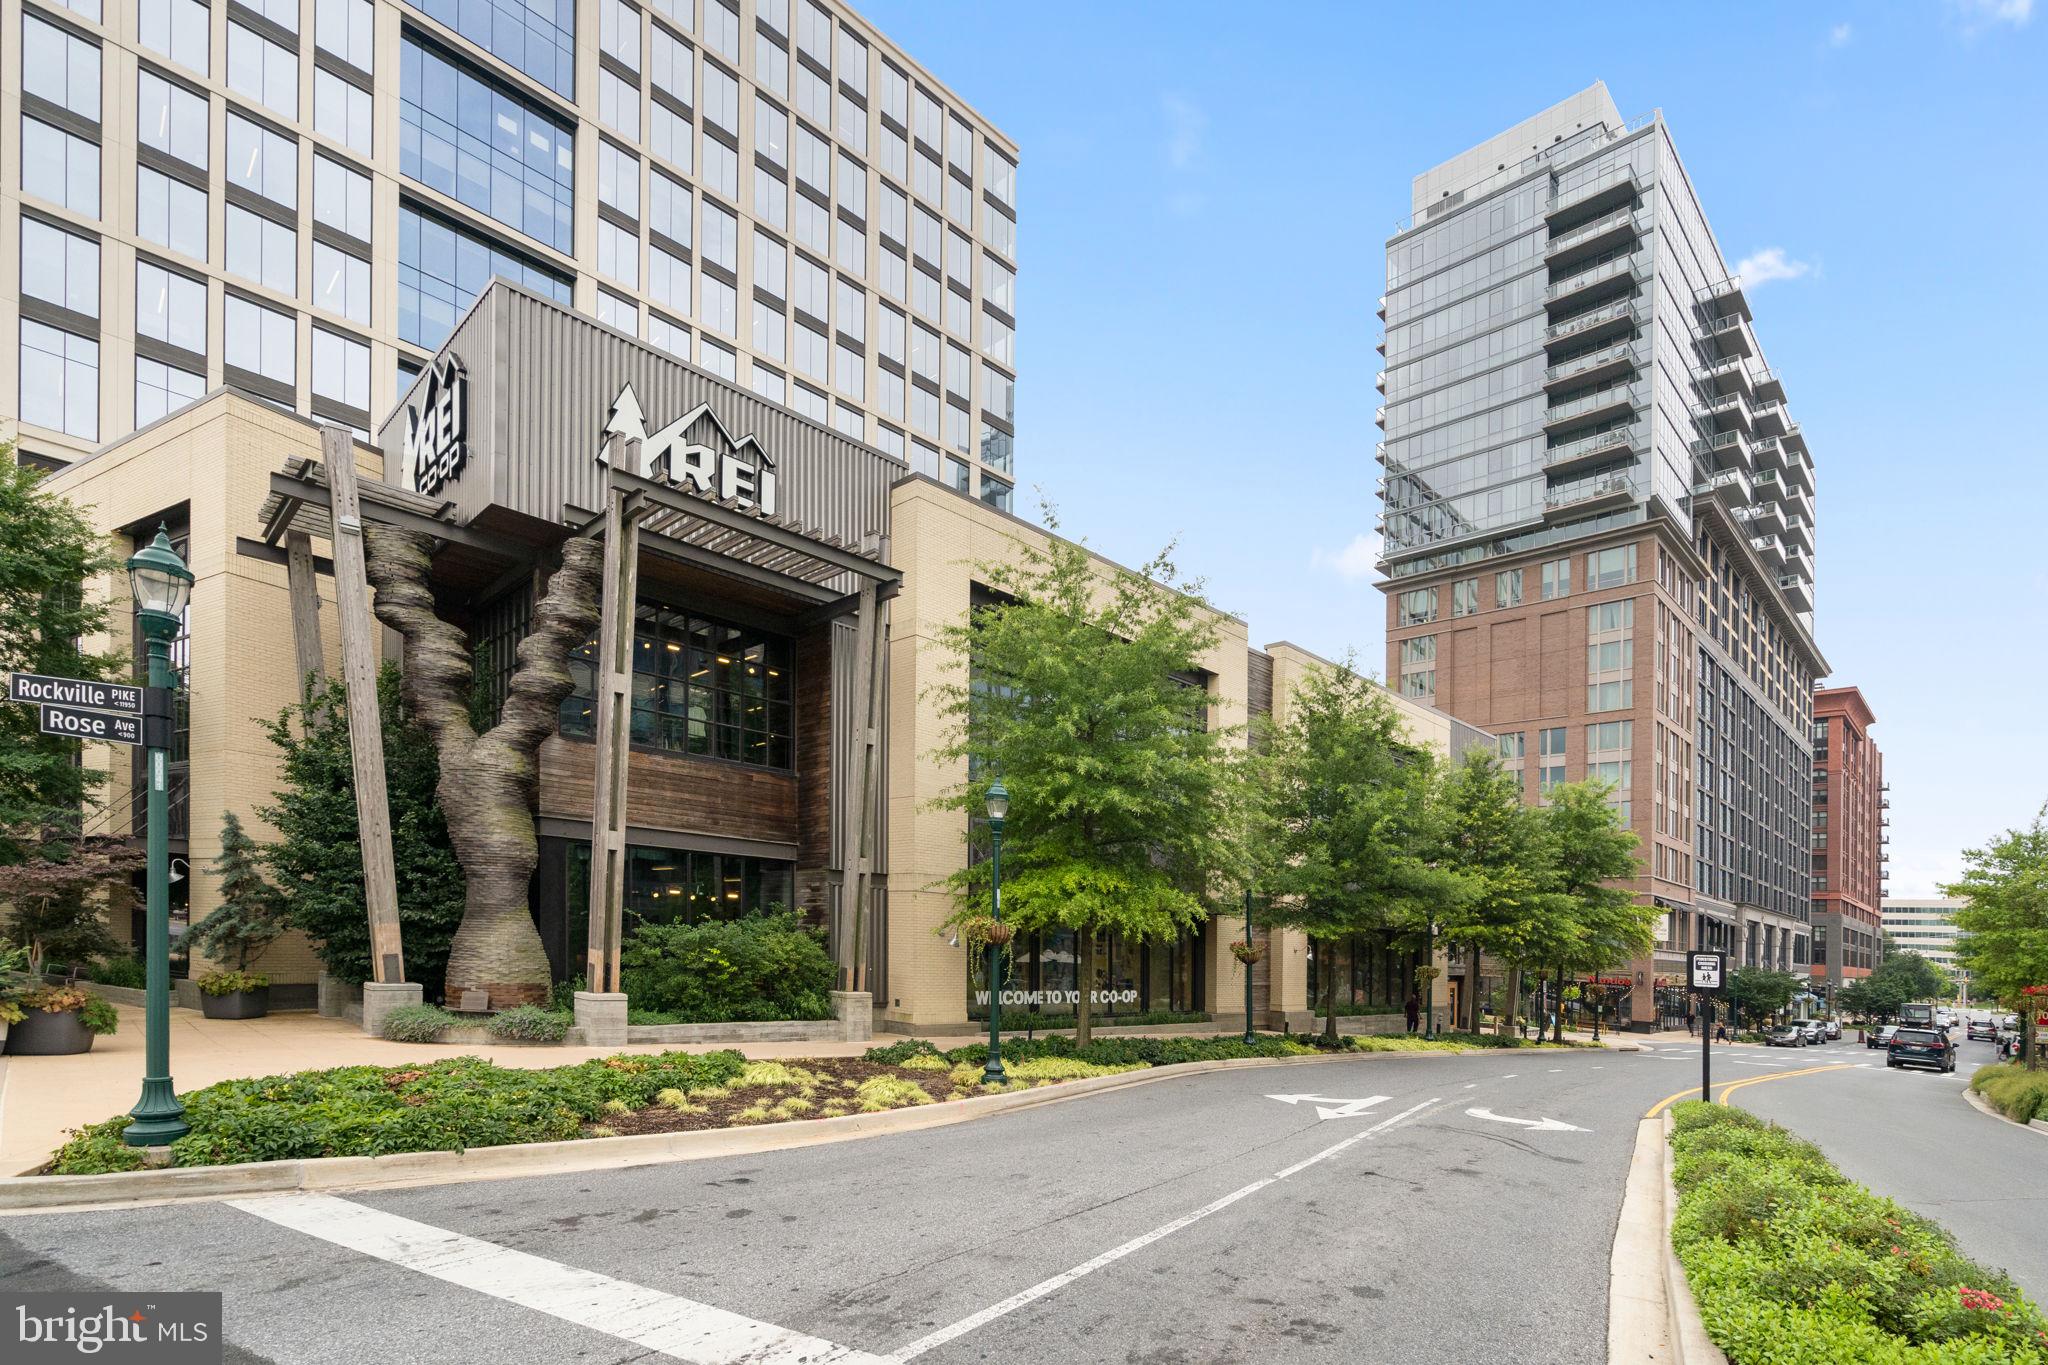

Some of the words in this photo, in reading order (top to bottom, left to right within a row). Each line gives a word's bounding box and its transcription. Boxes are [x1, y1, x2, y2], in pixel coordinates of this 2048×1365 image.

[419, 379, 462, 475] REI
[669, 442, 776, 516] REI
[18, 678, 105, 705] Rockville
[111, 689, 136, 702] PIKE
[50, 710, 106, 735] Rose
[114, 719, 135, 732] Ave
[1046, 990, 1062, 1005] TO
[1065, 990, 1098, 1004] YOR
[1100, 989, 1138, 1004] CO-OP
